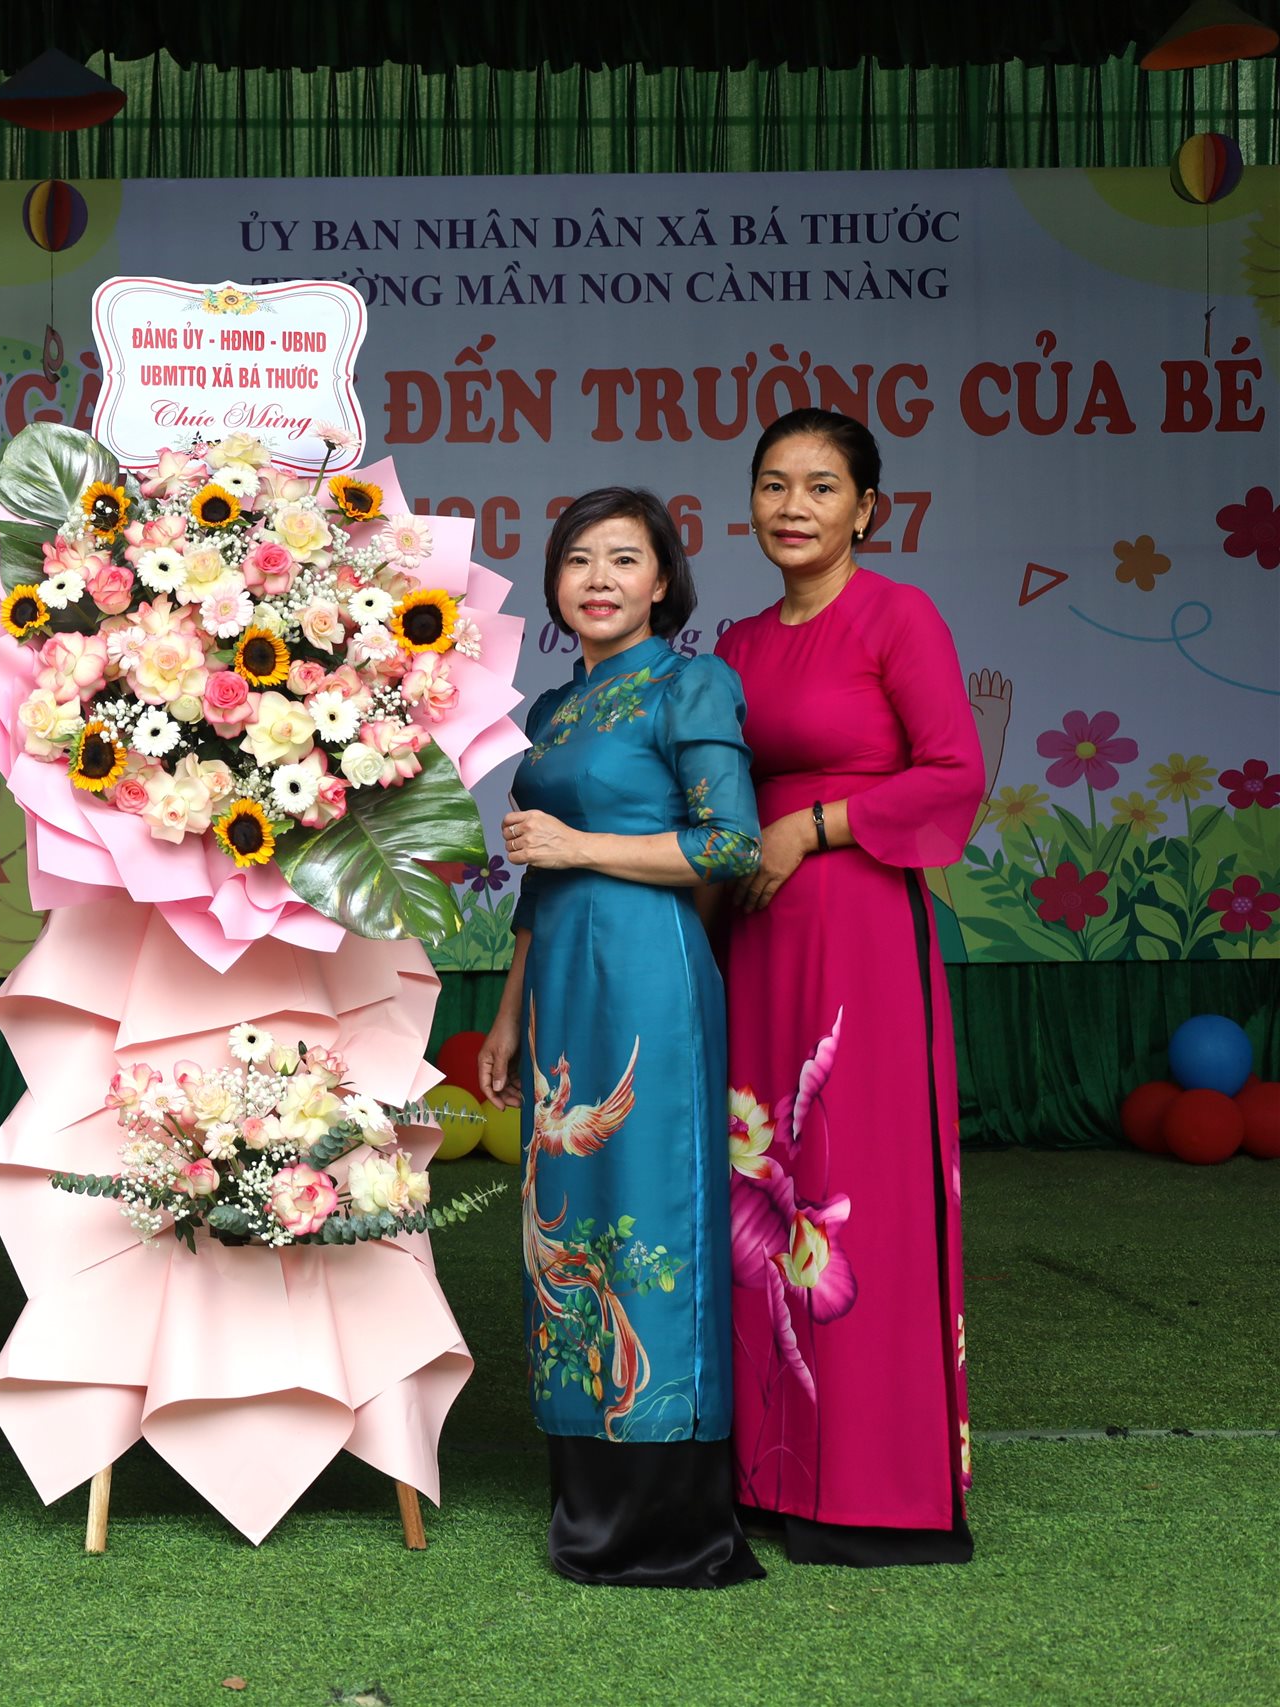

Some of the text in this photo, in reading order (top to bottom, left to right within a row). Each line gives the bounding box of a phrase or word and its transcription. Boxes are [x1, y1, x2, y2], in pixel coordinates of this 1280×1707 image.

[238, 203, 960, 251] ỦY BAN NHÂN DÂN XÃ BÁ THƯỚC
[455, 260, 567, 305] MẦM
[578, 272, 672, 305] NON
[686, 262, 811, 303] CÀNH
[823, 260, 949, 301] NÀNG
[132, 320, 177, 349] ĐẢNG
[183, 321, 204, 350] ỦY
[221, 330, 265, 351] HĐND
[282, 331, 327, 353] UBND
[141, 363, 318, 389] UBMTTQ XÃ BÁ THƯỚC
[384, 333, 556, 444] ĐẾN
[581, 342, 934, 442] TRƯỜNG
[959, 329, 1136, 436] CỦA
[1160, 336, 1265, 433] BÉ
[150, 399, 313, 440] Chúc Mừng
